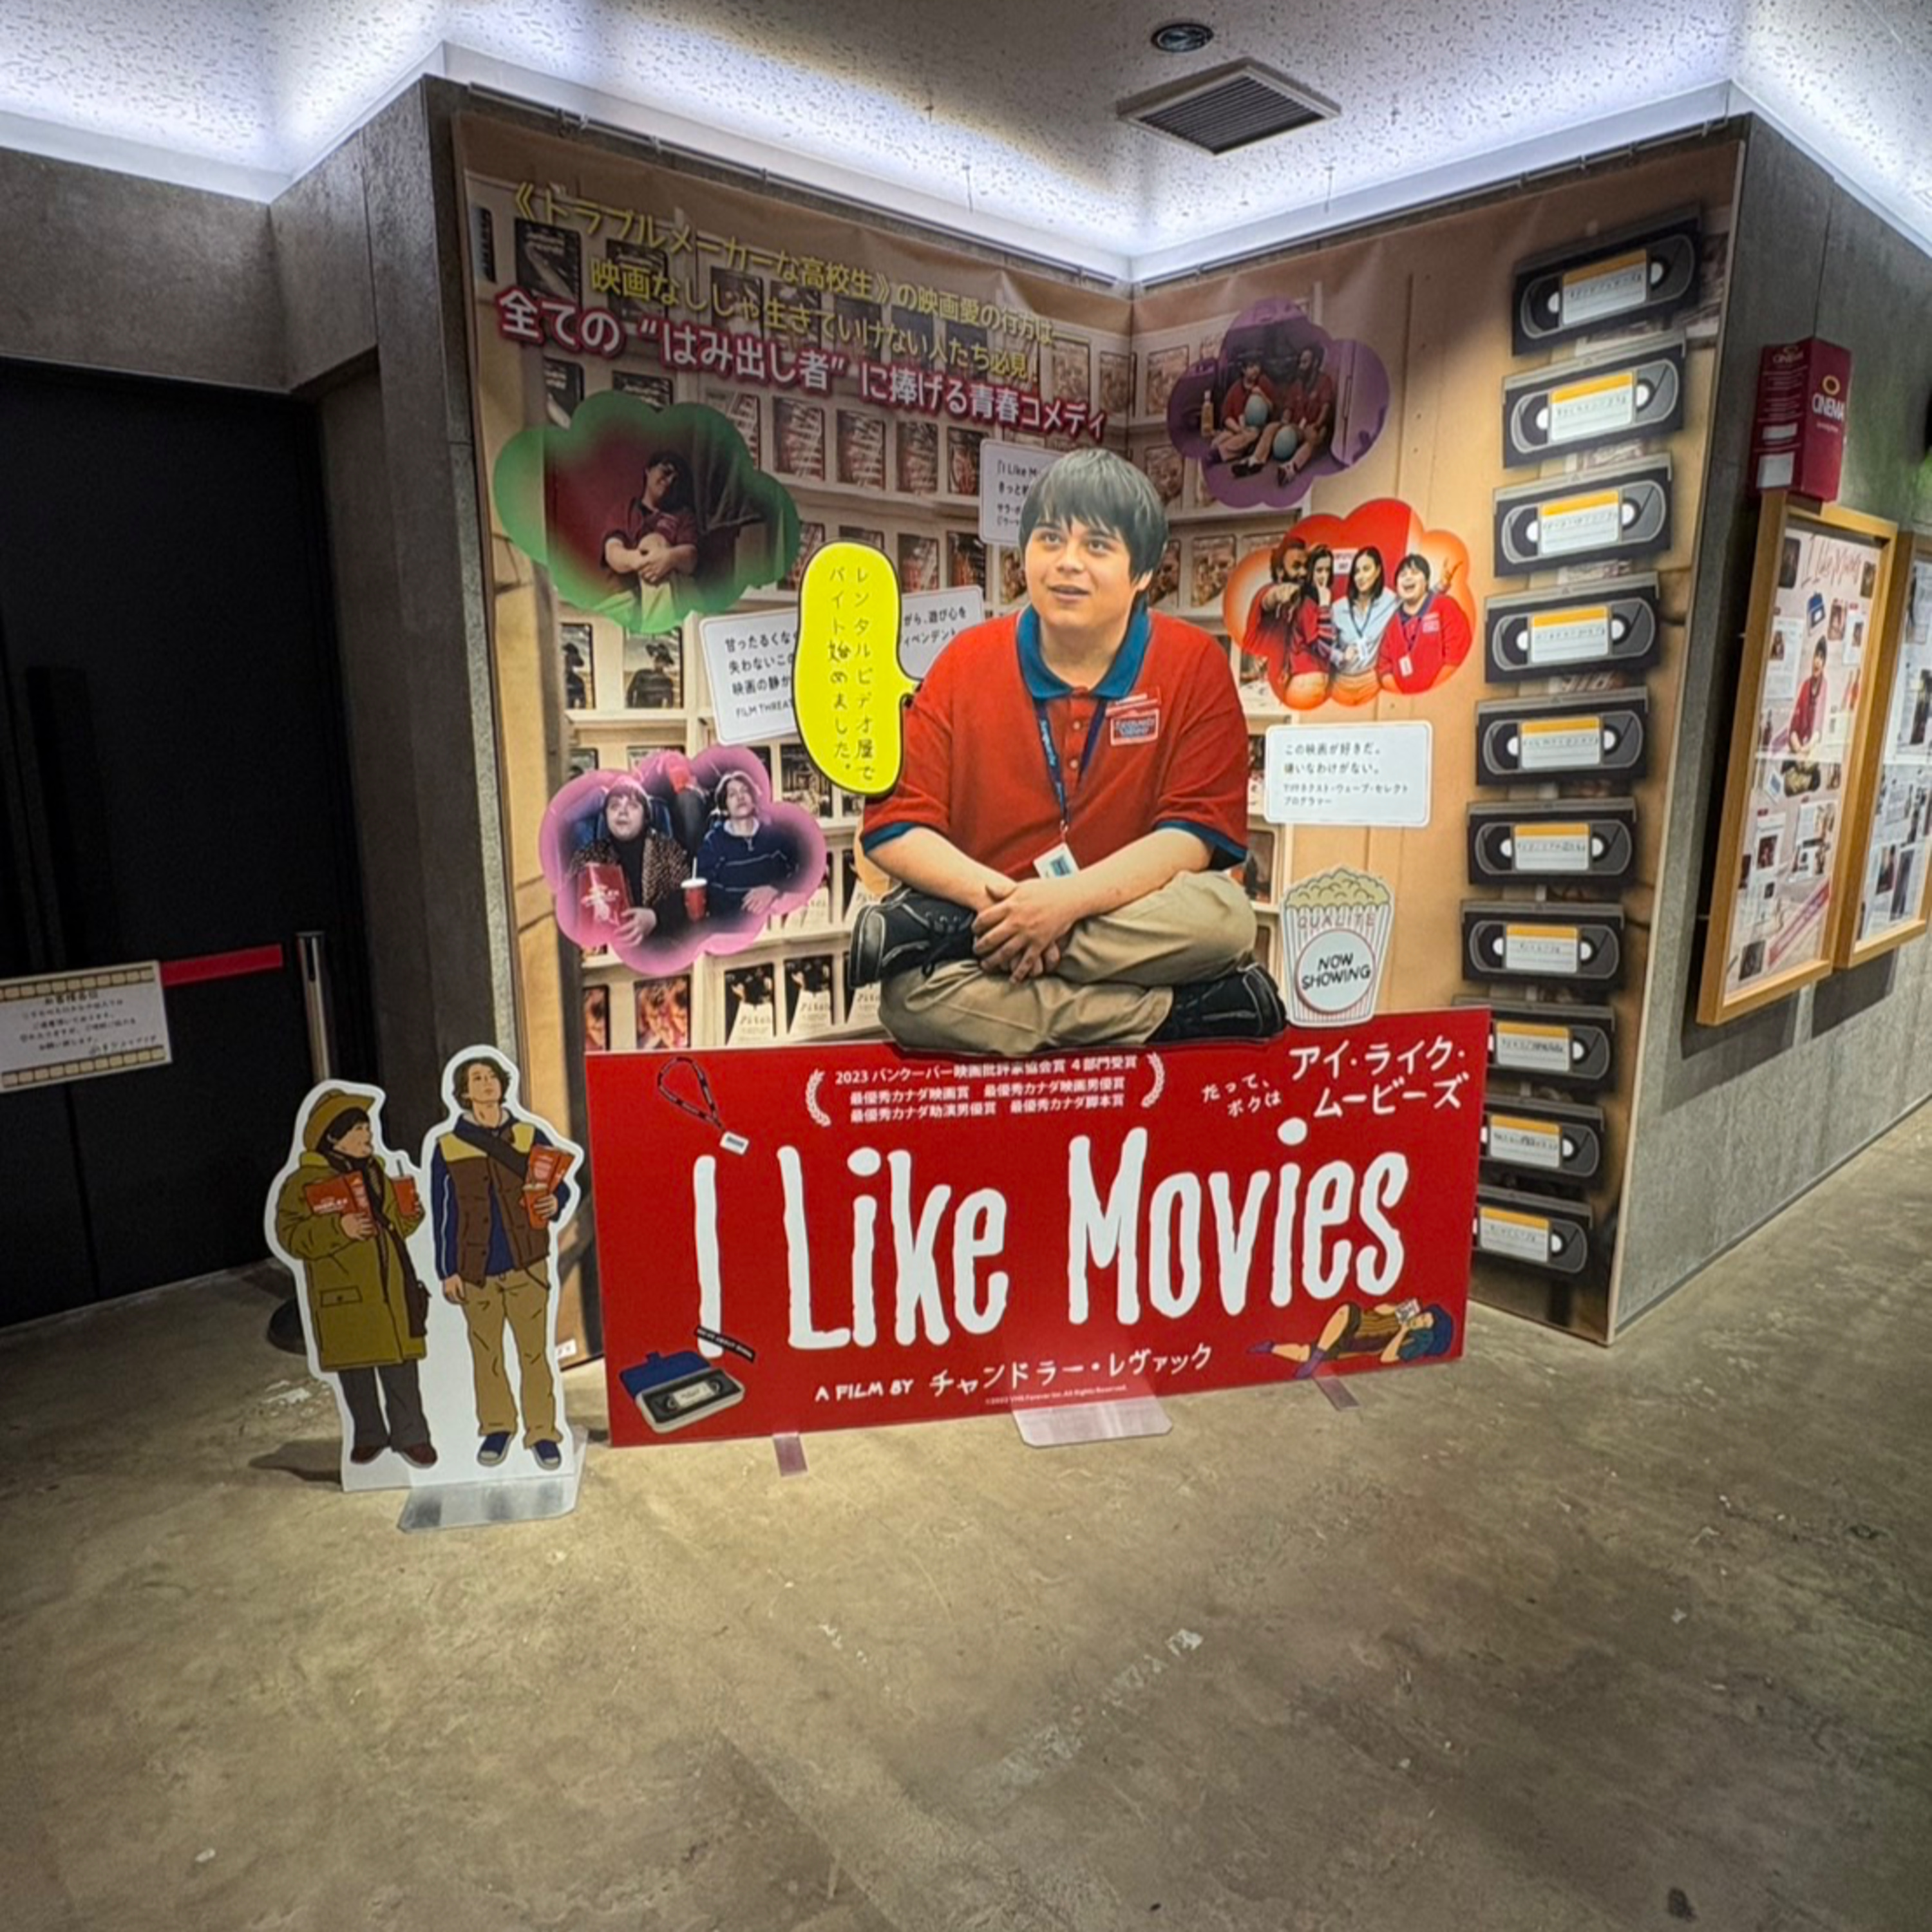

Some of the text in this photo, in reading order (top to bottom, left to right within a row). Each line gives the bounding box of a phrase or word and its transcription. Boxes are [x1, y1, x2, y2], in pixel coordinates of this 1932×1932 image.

[725, 630, 797, 653] 甘ったるくな
[854, 567, 875, 782] レンタルビデオ屋で
[736, 705, 757, 718] FILM
[1285, 741, 1380, 756] この映画が好きだ。
[1318, 953, 1354, 971] NOW
[1302, 963, 1371, 991] SHOWING
[835, 1070, 869, 1085] 2023
[850, 1077, 1125, 1106] 最優秀カナダ映画賞 最優秀カナダ映画男優賞
[1202, 1074, 1270, 1103] だって、
[850, 1094, 1124, 1124] 最優秀カナダ助演男優賞 最優秀カナダ脚本賞
[1227, 1090, 1282, 1117] ボクは
[1314, 1072, 1470, 1118] ムービーズ
[693, 1118, 1409, 1358] I Like Movies
[815, 1342, 1212, 1401] A FILM BY チャンドラー・レヴァック
